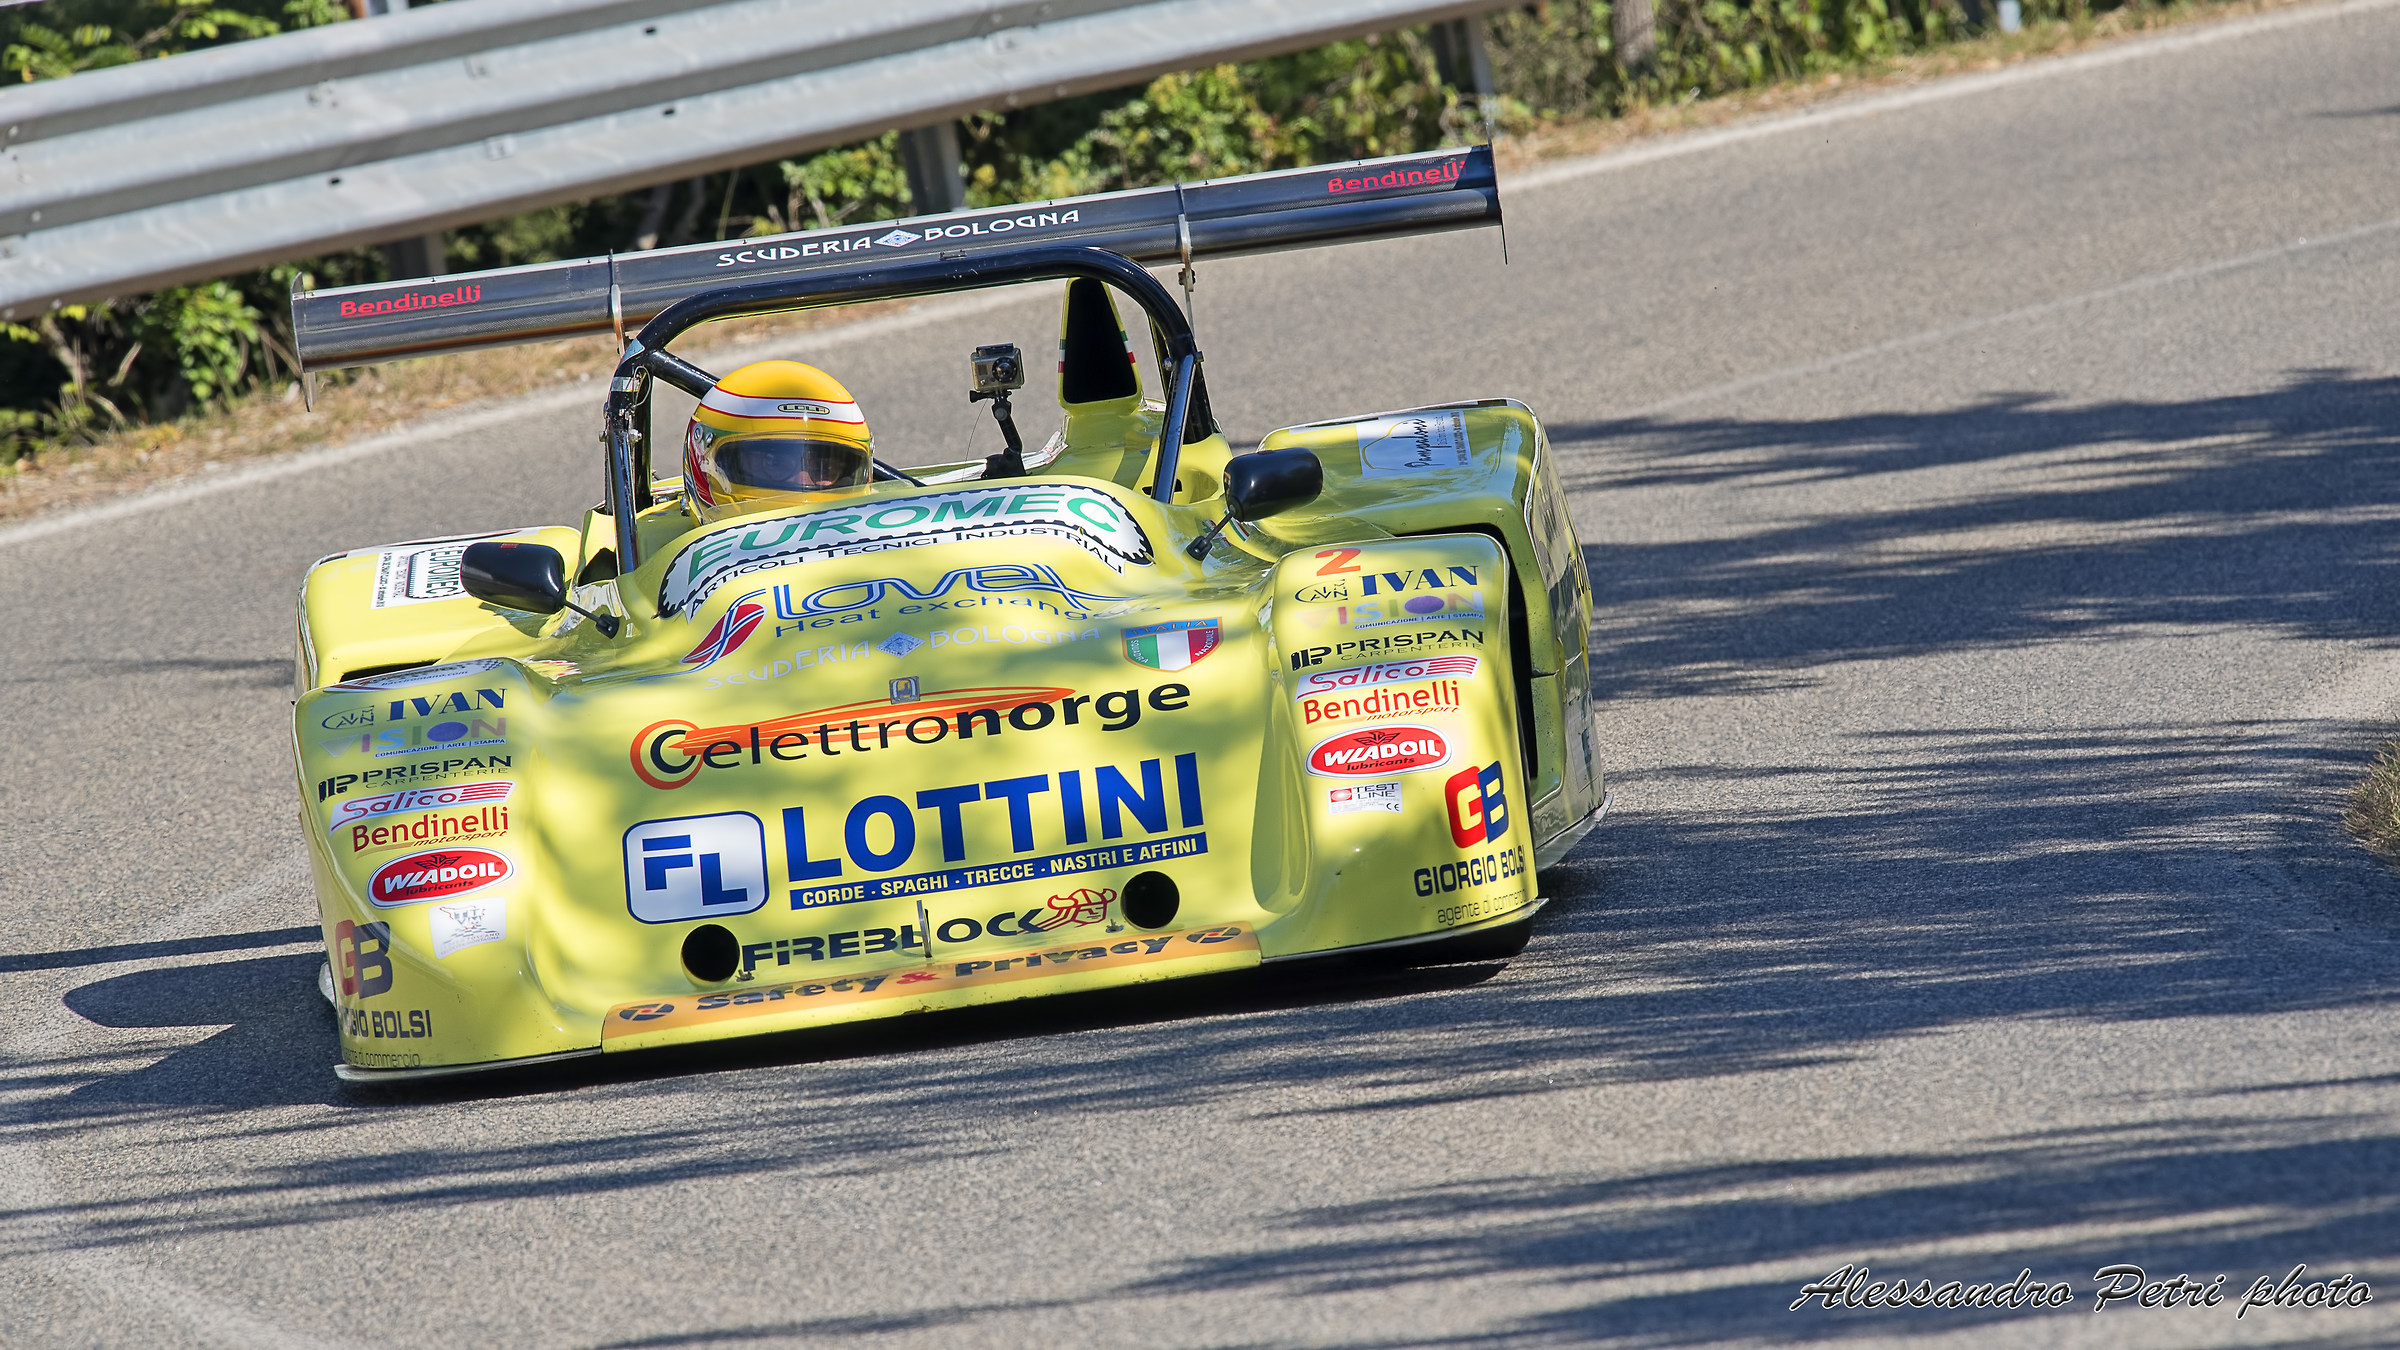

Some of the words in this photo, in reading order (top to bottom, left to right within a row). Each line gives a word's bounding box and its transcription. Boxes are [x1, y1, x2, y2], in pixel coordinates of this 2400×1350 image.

[716, 236, 872, 267] SCUDERIA
[924, 210, 1080, 241] BOLOGNA
[340, 285, 481, 317] Bendinelli
[688, 493, 1121, 586] EUROMEC
[426, 549, 463, 594] EUROMEC
[690, 556, 804, 620] ARTICOLI
[818, 537, 939, 558] TECNICI
[956, 527, 1123, 574] INDUSTRIALI
[1315, 547, 1361, 577] 2
[1360, 566, 1478, 597] IVAN
[775, 609, 881, 638] Heat
[1132, 620, 1207, 635] ITALIA
[1294, 592, 1484, 634] VISION
[1354, 616, 1419, 630] COMUNICAZIONE
[1453, 612, 1485, 620] STAMPA
[704, 640, 870, 690] SCUDERIA
[929, 625, 1100, 649] BOLOGNA
[1336, 629, 1485, 655] PRISPAN
[1341, 642, 1483, 661] CARPENTERIE
[1298, 664, 1424, 699] Salico
[387, 688, 507, 722] IVAN
[1303, 680, 1460, 725] Bendinelli
[1365, 706, 1460, 722] motorsport
[318, 717, 507, 759] VISION
[375, 745, 440, 758] COMUNICAZIONE
[474, 738, 506, 746] STAMPA
[1324, 739, 1442, 767] WLADOIL
[362, 755, 512, 783] PRISPAN
[366, 767, 509, 789] CARPENTERIE
[1347, 757, 1415, 771] lubricants
[1353, 783, 1399, 793] TEST
[1358, 790, 1395, 799] LINE
[331, 791, 457, 831] Salico
[782, 752, 1204, 882] LOTTINI
[1445, 760, 1509, 849] GB
[352, 806, 509, 852] Bendinelli
[413, 830, 508, 847] motorsport
[384, 862, 501, 894] WLADOIL
[642, 834, 748, 906] FL
[802, 885, 865, 907] CORDE
[880, 875, 949, 897] SPAGHI
[964, 863, 1035, 886] TRECCE
[1050, 851, 1118, 873] NASTRI
[1123, 848, 1134, 863] E
[1138, 838, 1198, 861] AFFINI
[1414, 854, 1497, 897] GIORGIO
[1500, 844, 1527, 879] BOLSI
[406, 880, 474, 896] lubricants
[1437, 902, 1480, 926] agente
[335, 919, 394, 1000] GB
[697, 974, 890, 1011] Safety
[896, 971, 941, 985] &
[955, 935, 1174, 976] Privacy
[371, 1009, 433, 1039] BOLSI
[366, 1052, 421, 1068] commercio
